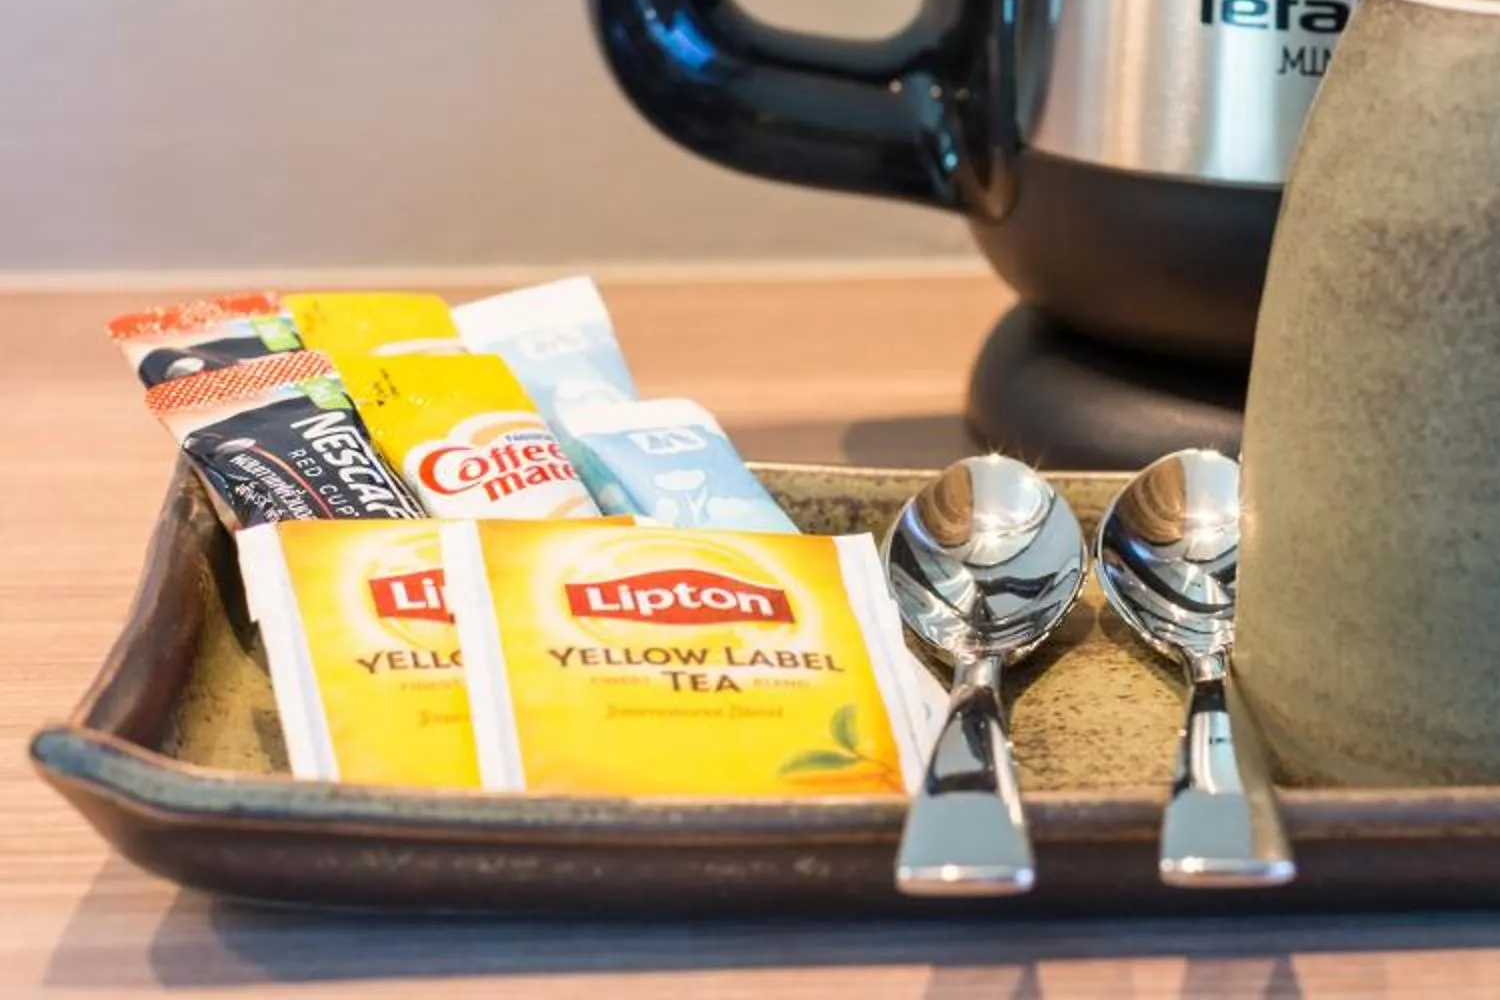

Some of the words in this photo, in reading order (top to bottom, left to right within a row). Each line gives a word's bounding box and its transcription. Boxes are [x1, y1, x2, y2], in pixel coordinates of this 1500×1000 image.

[288, 448, 324, 478] RED
[585, 582, 774, 616] Lipton
[549, 646, 707, 668] YELLOW
[724, 646, 845, 672] LABEL
[661, 670, 742, 694] TEA
